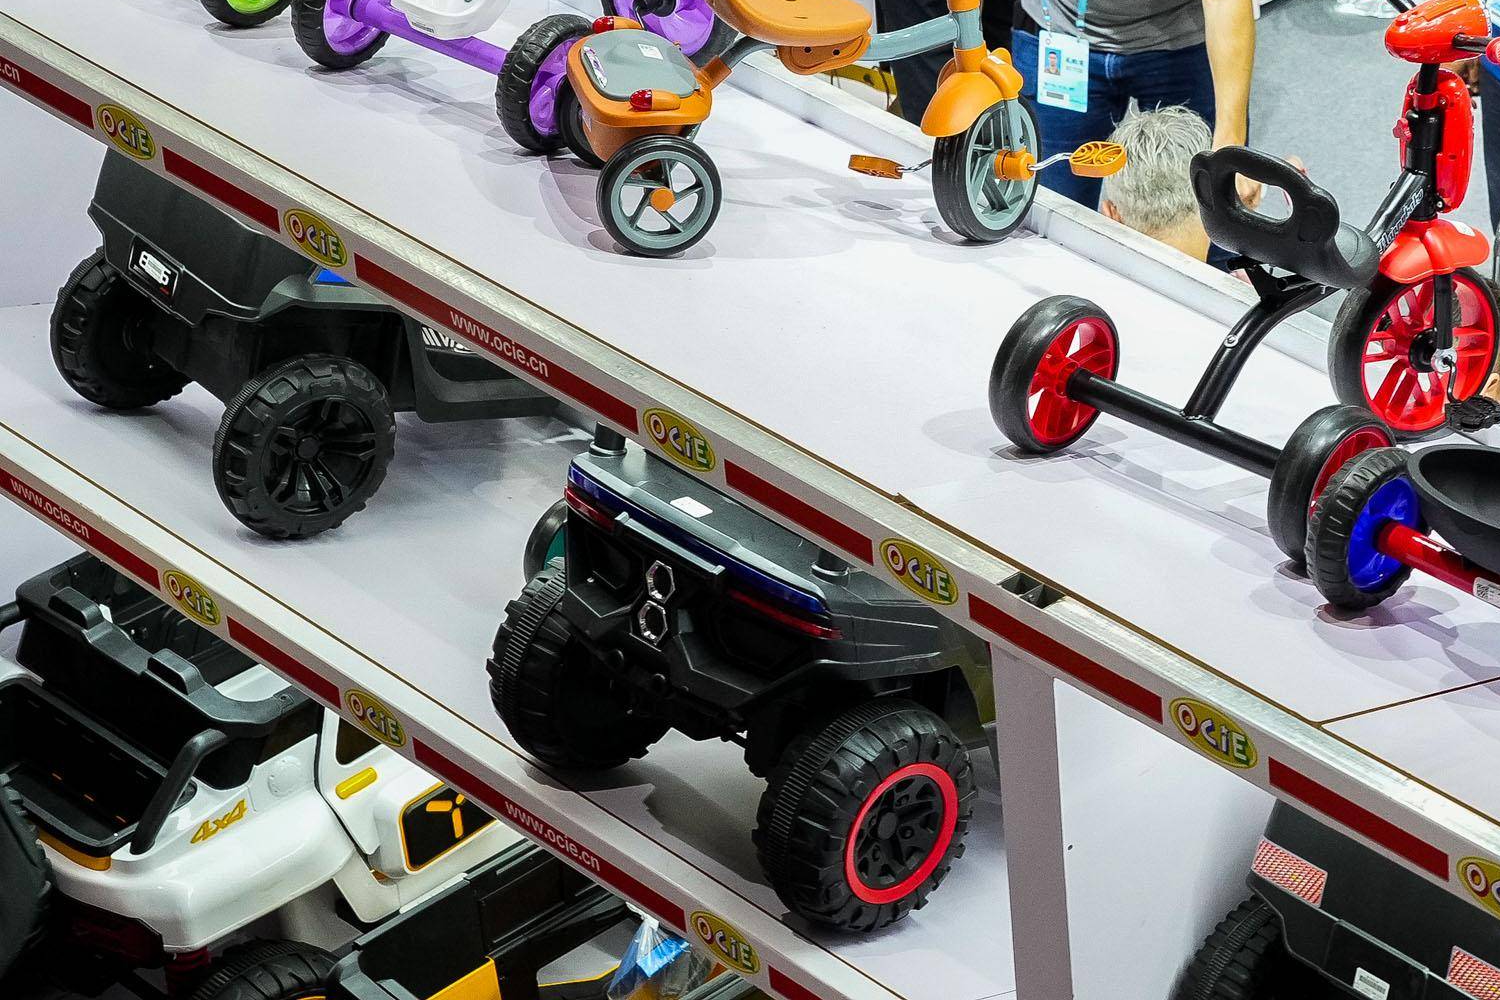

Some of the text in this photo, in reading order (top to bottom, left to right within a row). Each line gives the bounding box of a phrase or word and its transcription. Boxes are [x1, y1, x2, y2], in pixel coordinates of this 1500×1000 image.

[450, 309, 549, 378] www.ocie.cn
[10, 477, 90, 540] www.ocie.cn
[504, 800, 601, 872] www.ocie.cn
